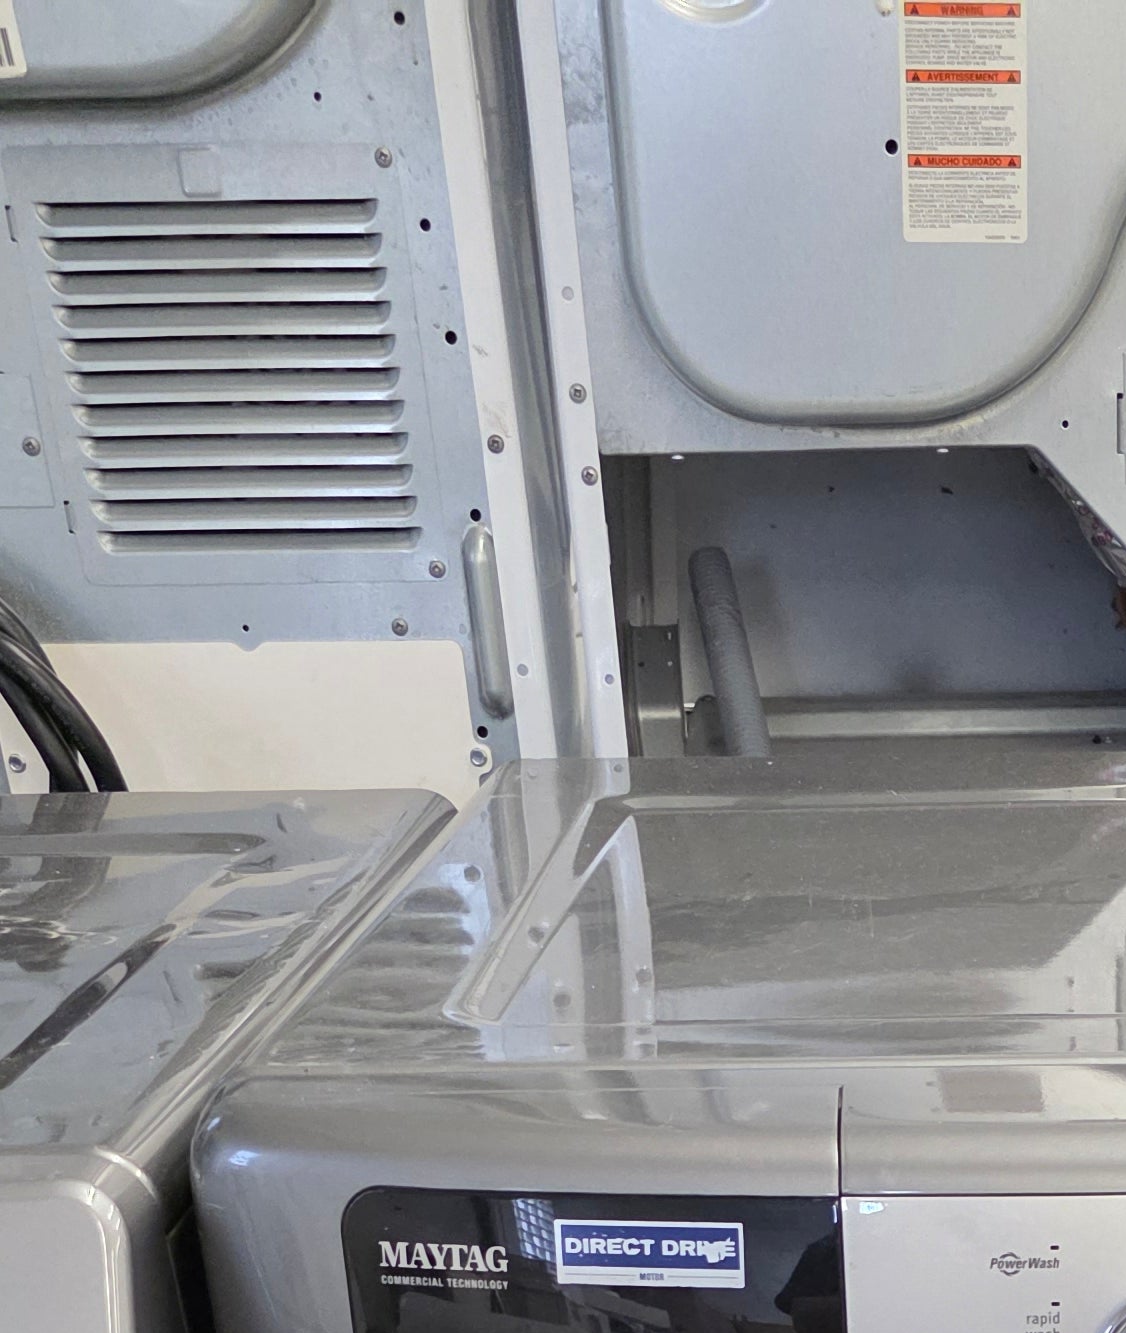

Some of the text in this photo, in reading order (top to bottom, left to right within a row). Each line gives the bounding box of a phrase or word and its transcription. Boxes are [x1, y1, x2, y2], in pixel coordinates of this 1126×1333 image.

[940, 5, 984, 16] WARNING
[927, 72, 999, 82] AVERTISSEMENT
[927, 157, 1002, 166] MUCHO CUIDADO
[565, 1237, 655, 1256] DIRECT
[378, 1240, 509, 1273] MAYTAG
[990, 1257, 1060, 1270] PowerWash
[381, 1275, 509, 1290] COMMERCIAL TECHNOLOGY
[639, 1272, 665, 1281] MOTOR
[1026, 1311, 1061, 1327] rapid
